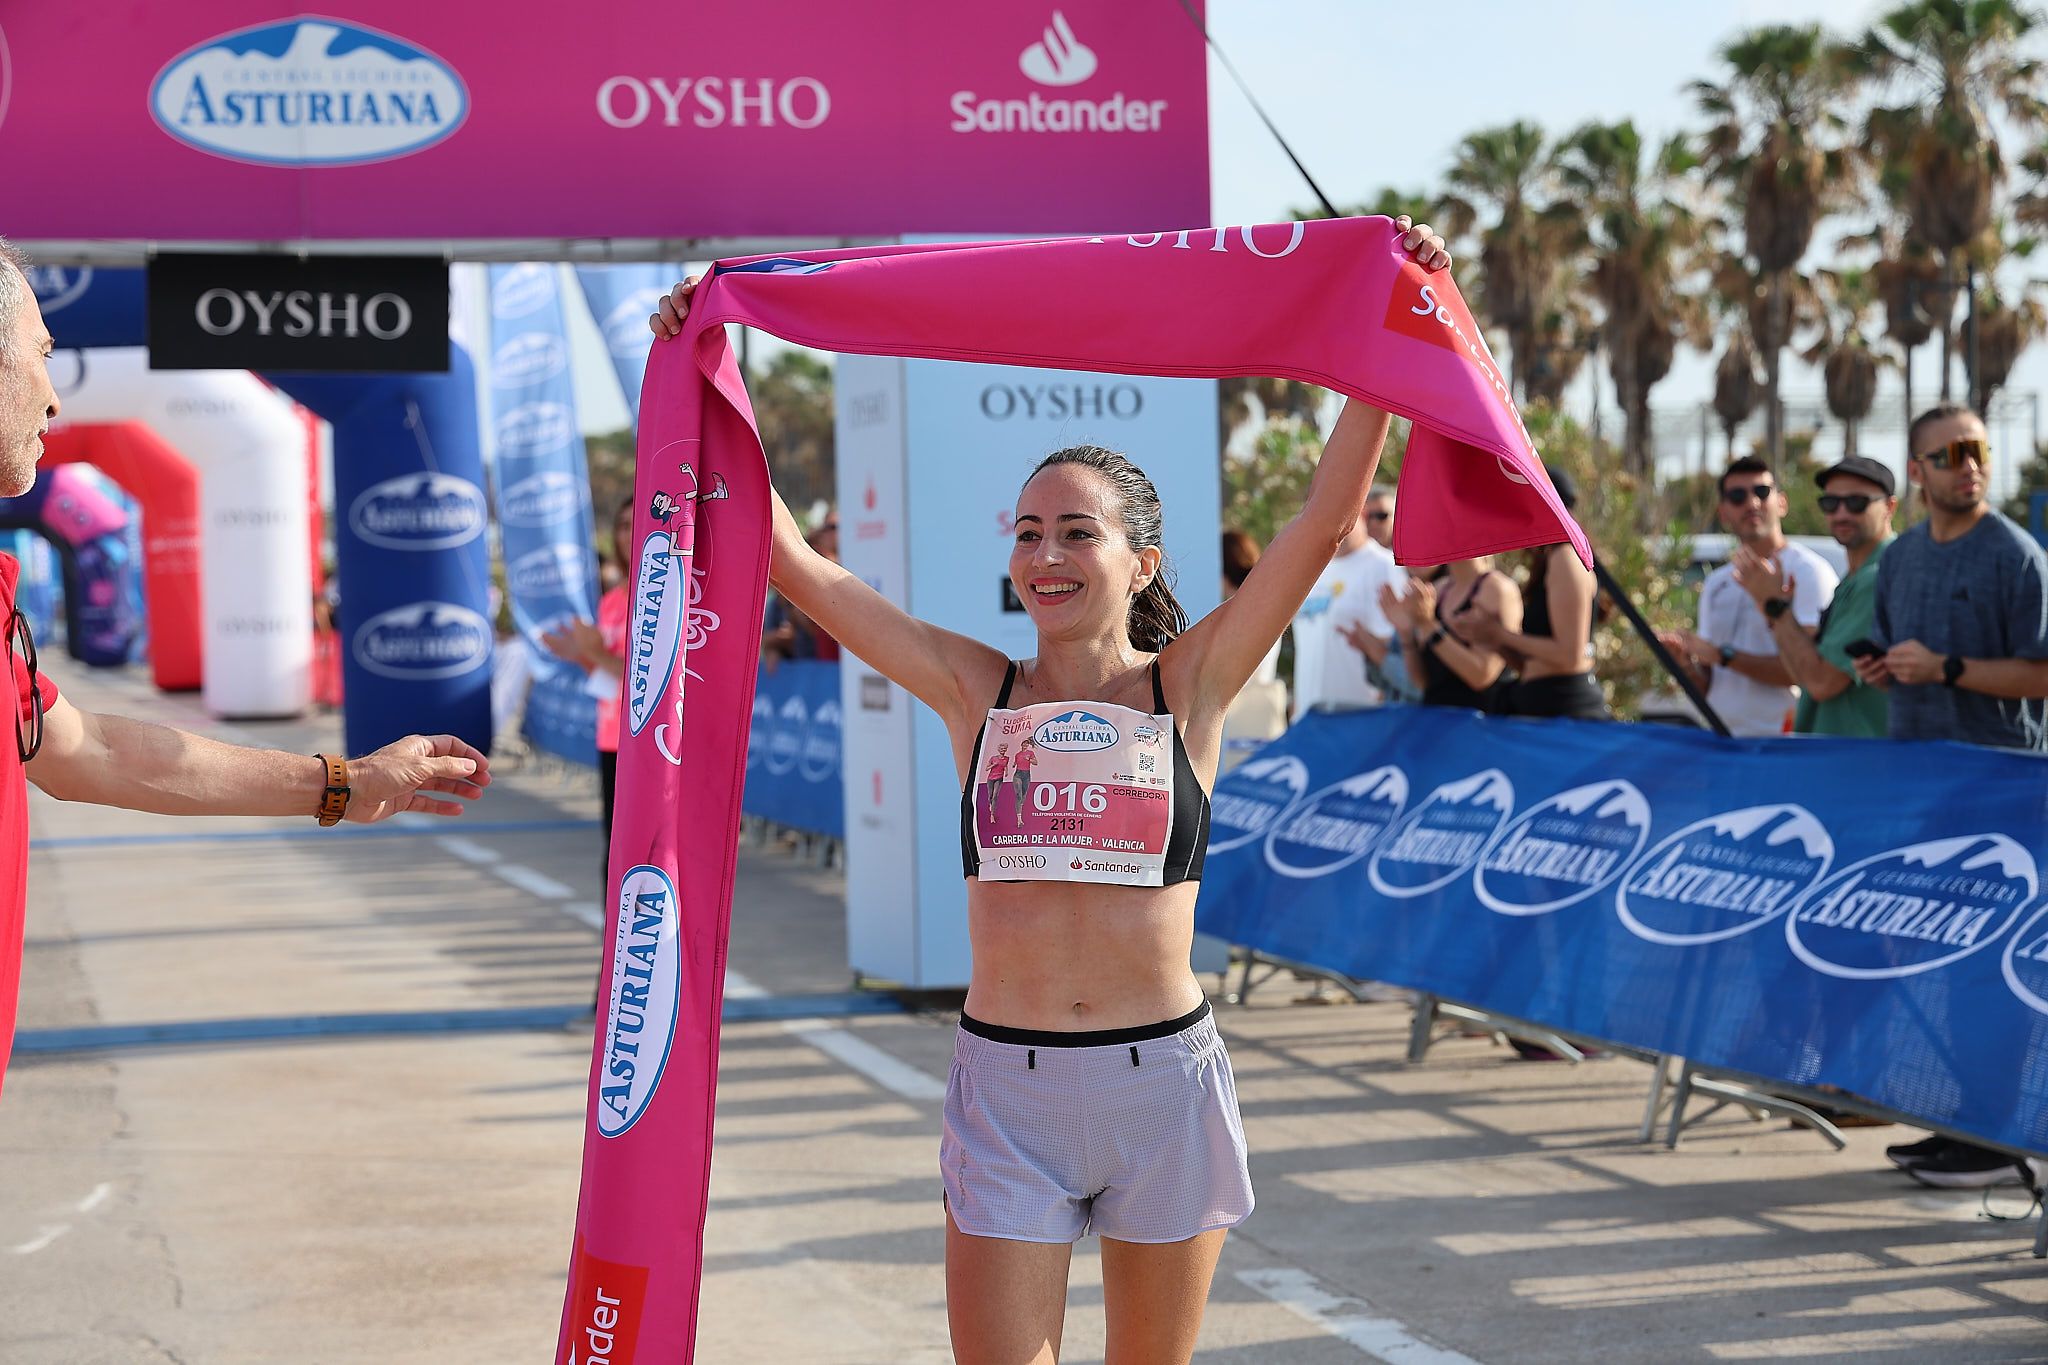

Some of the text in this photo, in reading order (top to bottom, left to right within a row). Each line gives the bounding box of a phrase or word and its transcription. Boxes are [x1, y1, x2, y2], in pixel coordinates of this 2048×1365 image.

[179, 73, 441, 125] ASTURIANA
[595, 76, 831, 129] OYSHO
[950, 91, 1168, 133] Santander
[195, 288, 412, 339] OYSHO
[980, 383, 1144, 421] OYSHO
[631, 550, 671, 723] ASTURIANA
[1002, 720, 1032, 735] SUMA
[1039, 727, 1113, 743] ASTURIANA
[1033, 783, 1108, 813] 016
[1112, 788, 1166, 800] CORREDORA
[992, 834, 1146, 851] CARRERA DE LA MUJER VALENCIA
[1050, 818, 1084, 832] 2131
[999, 855, 1047, 869] OYSHO
[1084, 860, 1142, 874] Santander
[1628, 841, 1796, 915] ASTURIANA
[1798, 870, 1997, 947] ASTURIANA
[614, 891, 631, 976] LECHERA
[600, 889, 667, 1121] ASTURIANA
